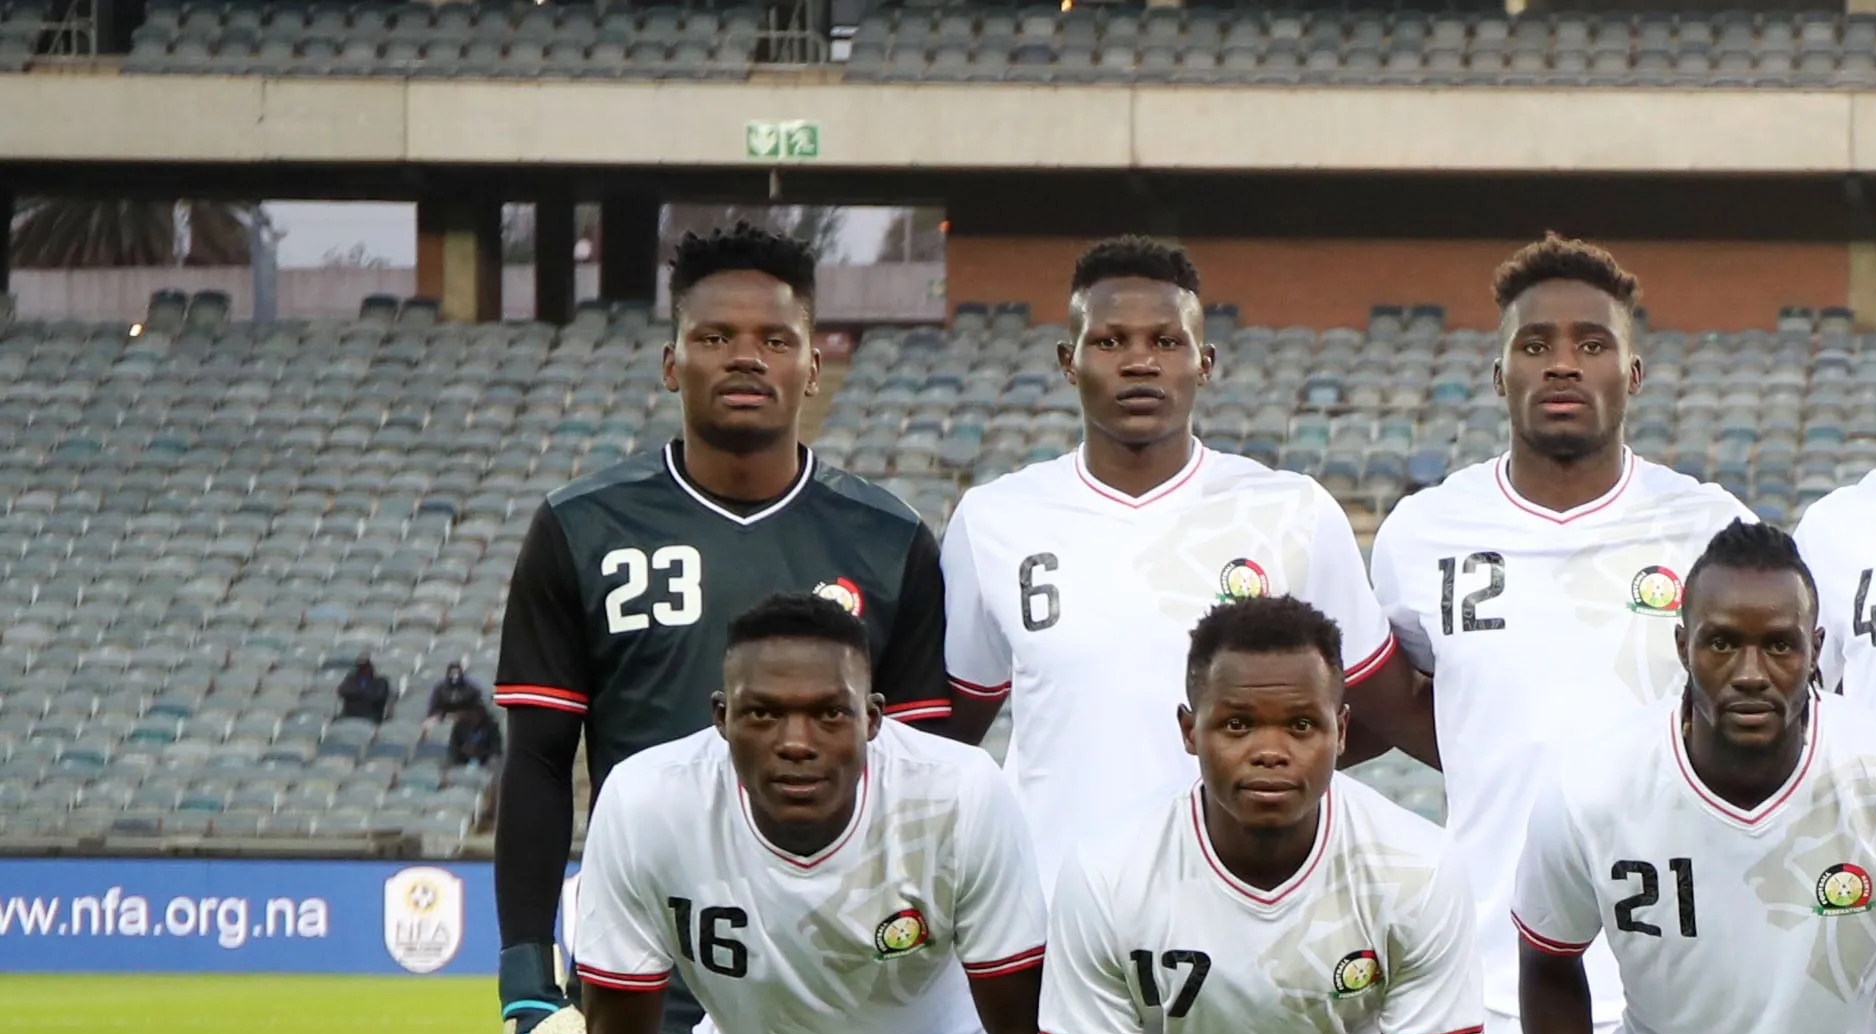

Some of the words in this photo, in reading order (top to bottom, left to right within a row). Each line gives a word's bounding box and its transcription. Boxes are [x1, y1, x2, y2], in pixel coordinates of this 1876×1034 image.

[601, 545, 702, 634] 23
[1019, 552, 1060, 632] 6
[1438, 552, 1506, 635] 12
[668, 896, 748, 978] 16
[1611, 857, 1698, 938] 21
[1130, 949, 1212, 1019] 17
